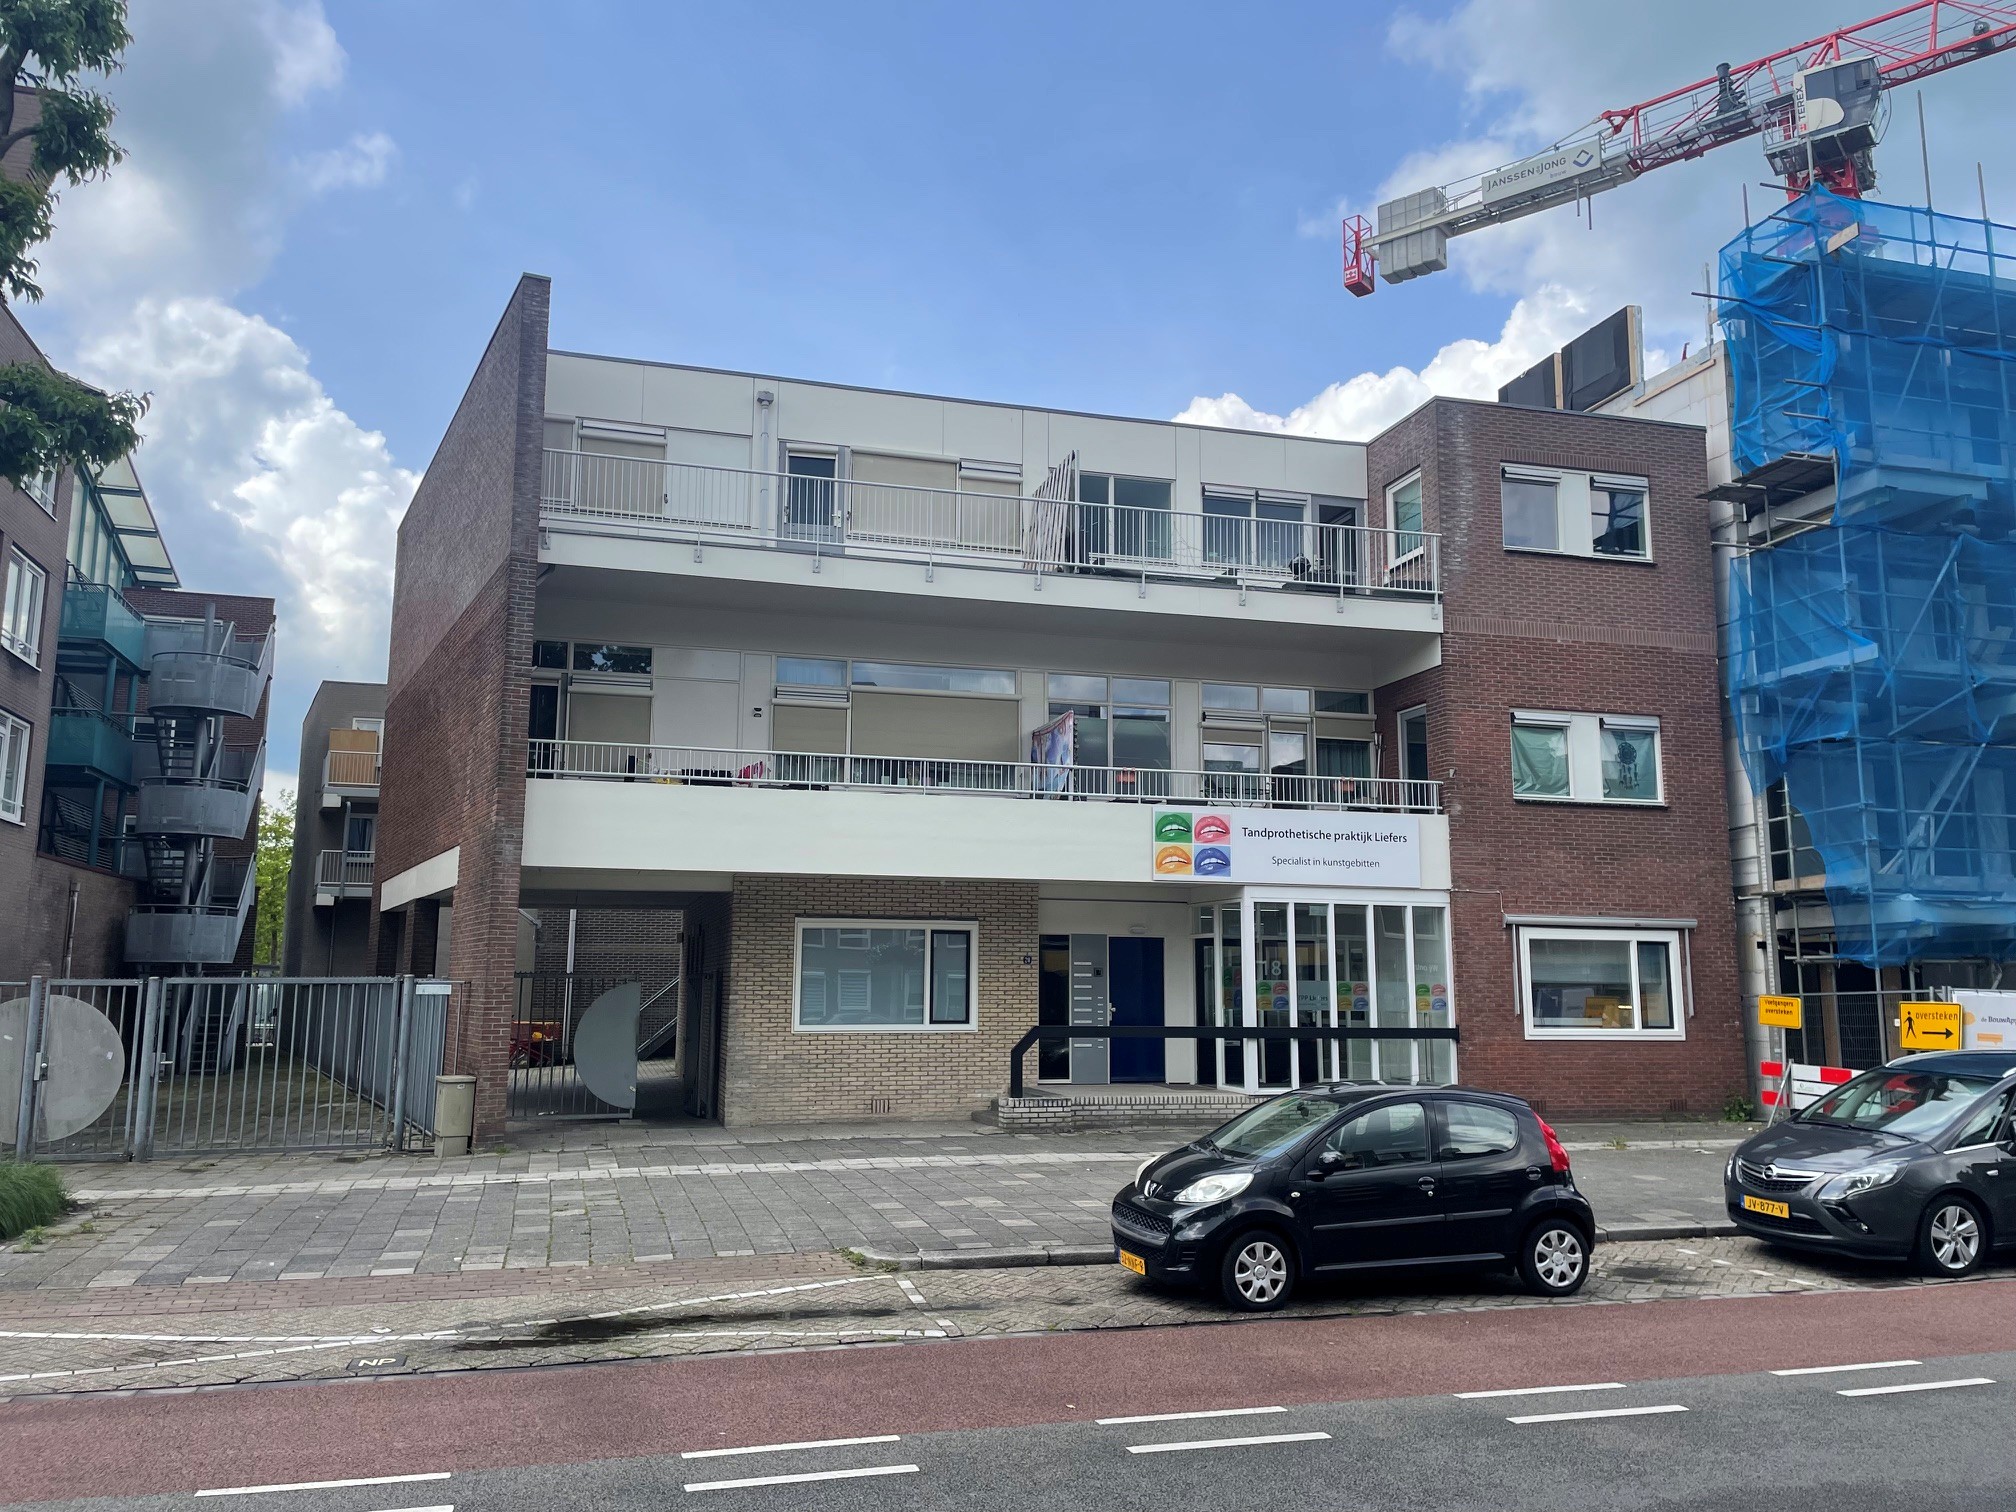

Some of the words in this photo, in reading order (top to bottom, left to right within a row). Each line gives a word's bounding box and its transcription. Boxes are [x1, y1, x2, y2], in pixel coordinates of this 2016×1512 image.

[1796, 84, 1805, 122] TEREX
[1487, 167, 1535, 192] JANSSEN
[1242, 827, 1332, 841] Tandprothetische
[1334, 831, 1373, 844] praktijk
[1374, 831, 1407, 843] Liefers
[1272, 856, 1312, 868] Specialist
[1313, 857, 1321, 866] in
[1322, 857, 1380, 869] kunstgebitten
[1915, 1011, 1958, 1021] oversteken
[1747, 1198, 1784, 1215] JV-877-V
[358, 1358, 396, 1367] NP
